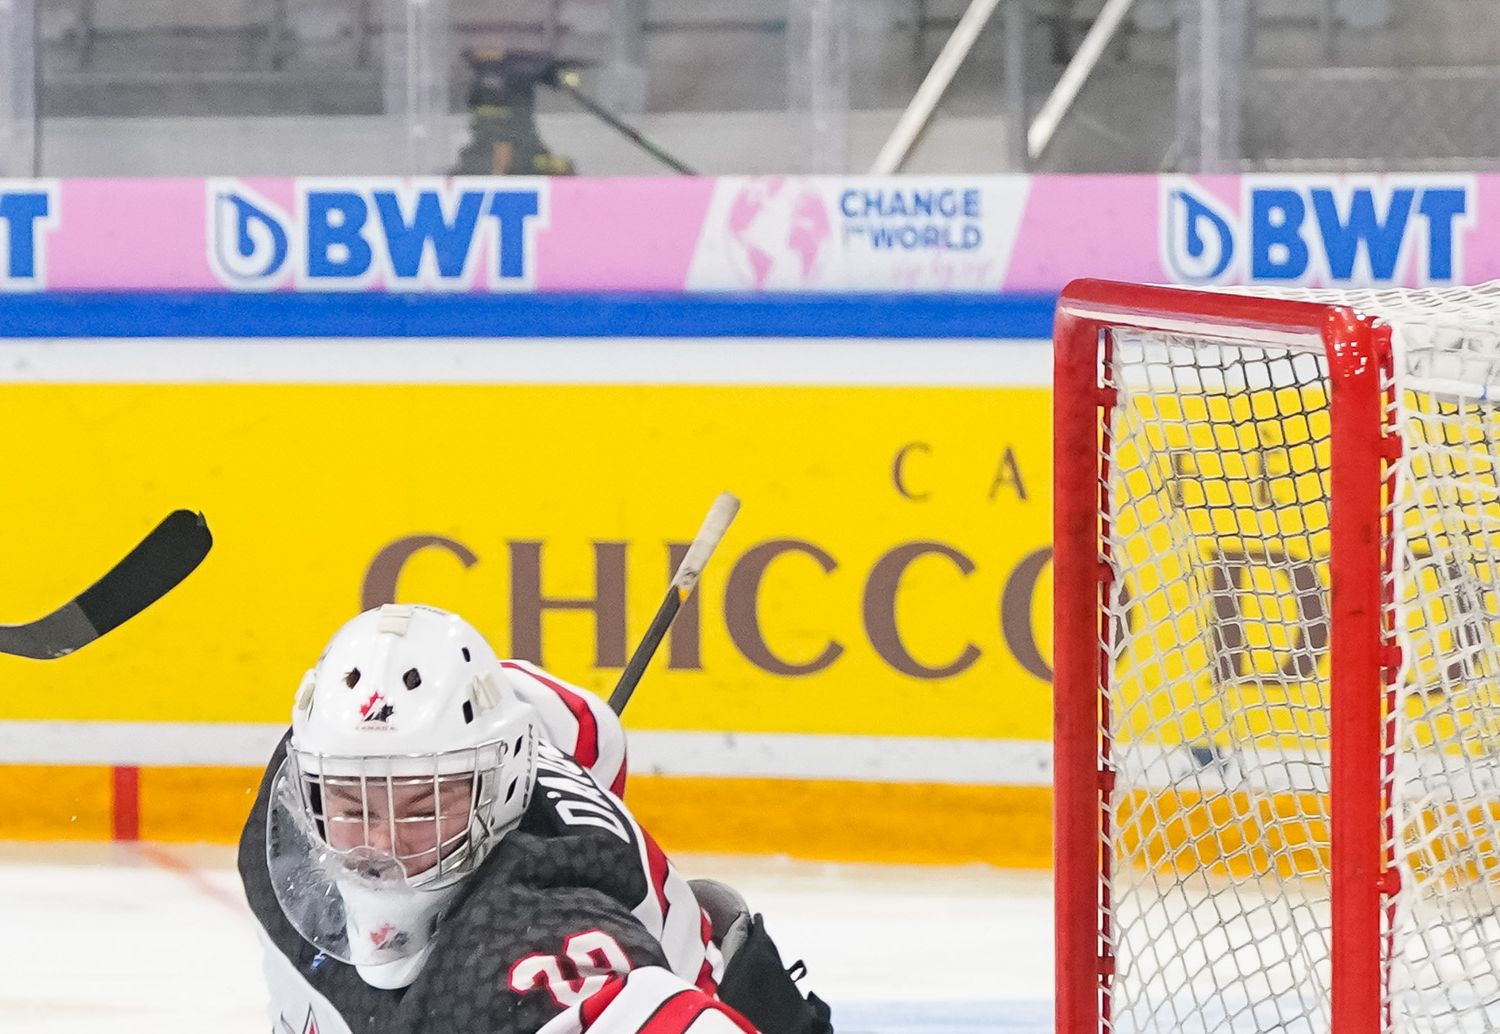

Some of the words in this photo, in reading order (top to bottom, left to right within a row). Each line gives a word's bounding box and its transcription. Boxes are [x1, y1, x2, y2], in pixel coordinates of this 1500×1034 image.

[840, 187, 982, 218] CHANGE
[306, 190, 539, 278] BWT
[872, 225, 982, 249] WORLD
[1252, 189, 1466, 280] BWT
